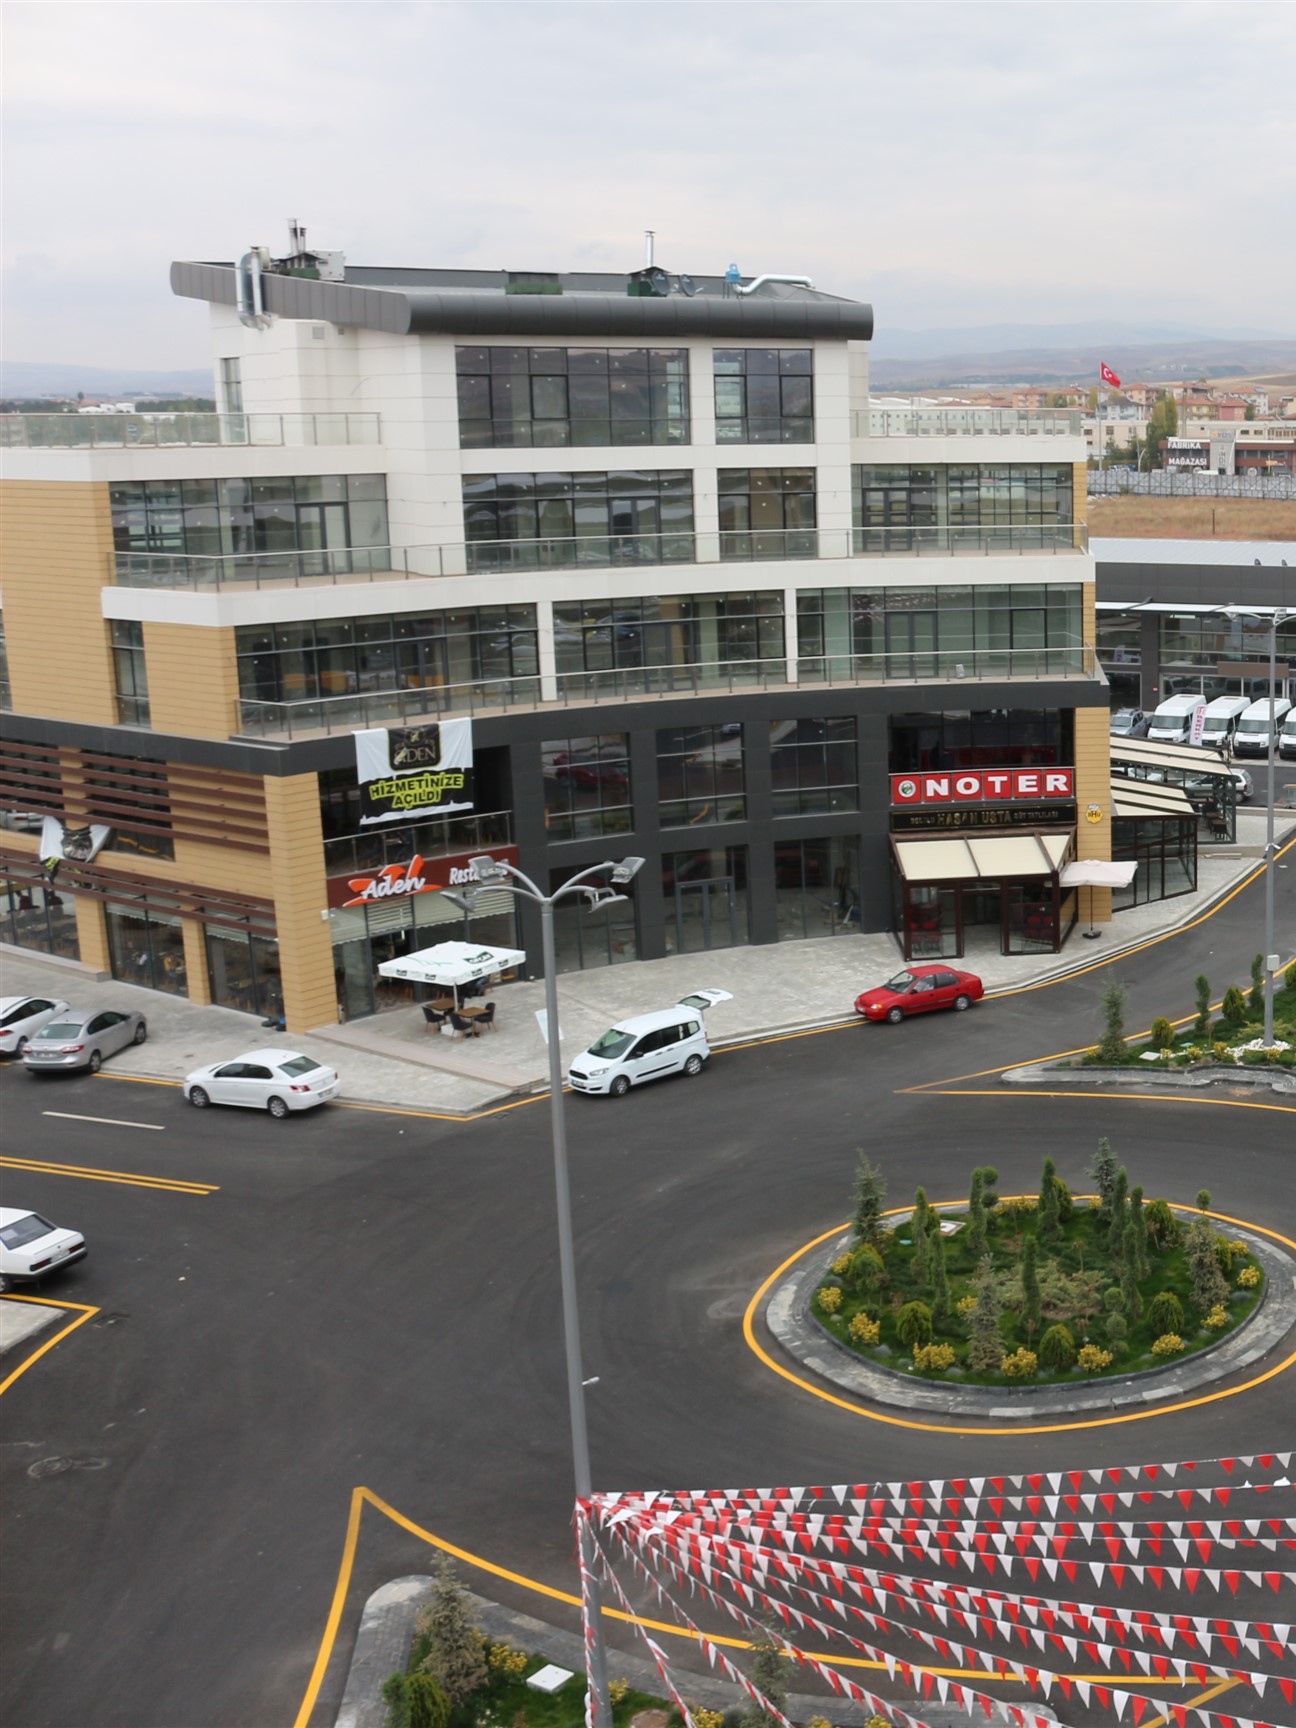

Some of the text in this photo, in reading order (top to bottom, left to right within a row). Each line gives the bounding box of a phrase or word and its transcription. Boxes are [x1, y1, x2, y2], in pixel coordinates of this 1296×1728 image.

[1168, 456, 1207, 466] MAĞAZASI
[371, 773, 462, 797] HİZMETİNİZE
[926, 775, 1068, 797] NOTER
[394, 789, 439, 807] AÇILDI
[937, 813, 978, 825] HASAN
[981, 810, 1012, 823] USTA
[361, 875, 425, 899] Aden
